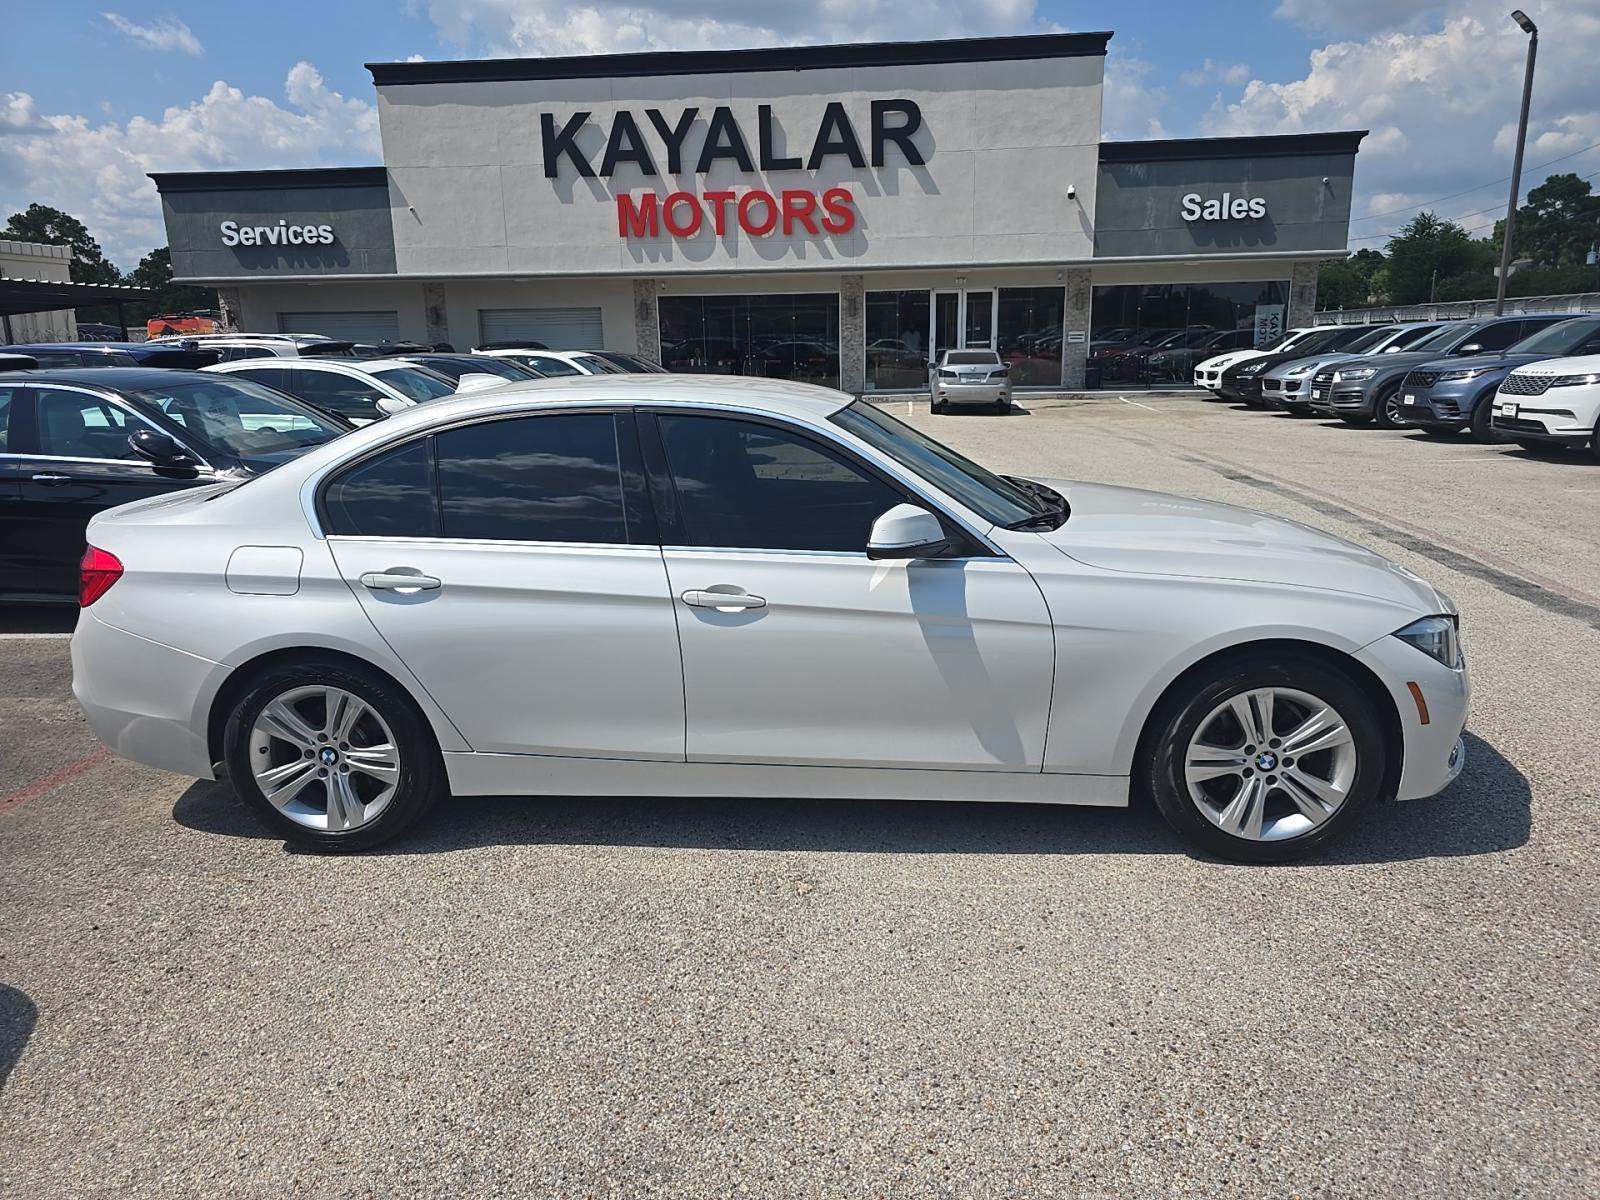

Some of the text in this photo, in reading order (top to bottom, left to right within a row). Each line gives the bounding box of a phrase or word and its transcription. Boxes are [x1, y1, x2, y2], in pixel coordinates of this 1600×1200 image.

[541, 99, 926, 178] KAYALAR
[617, 188, 854, 238] MOTORS
[1181, 192, 1266, 221] Sales
[220, 219, 335, 246] Services
[1269, 312, 1279, 339] KAY
